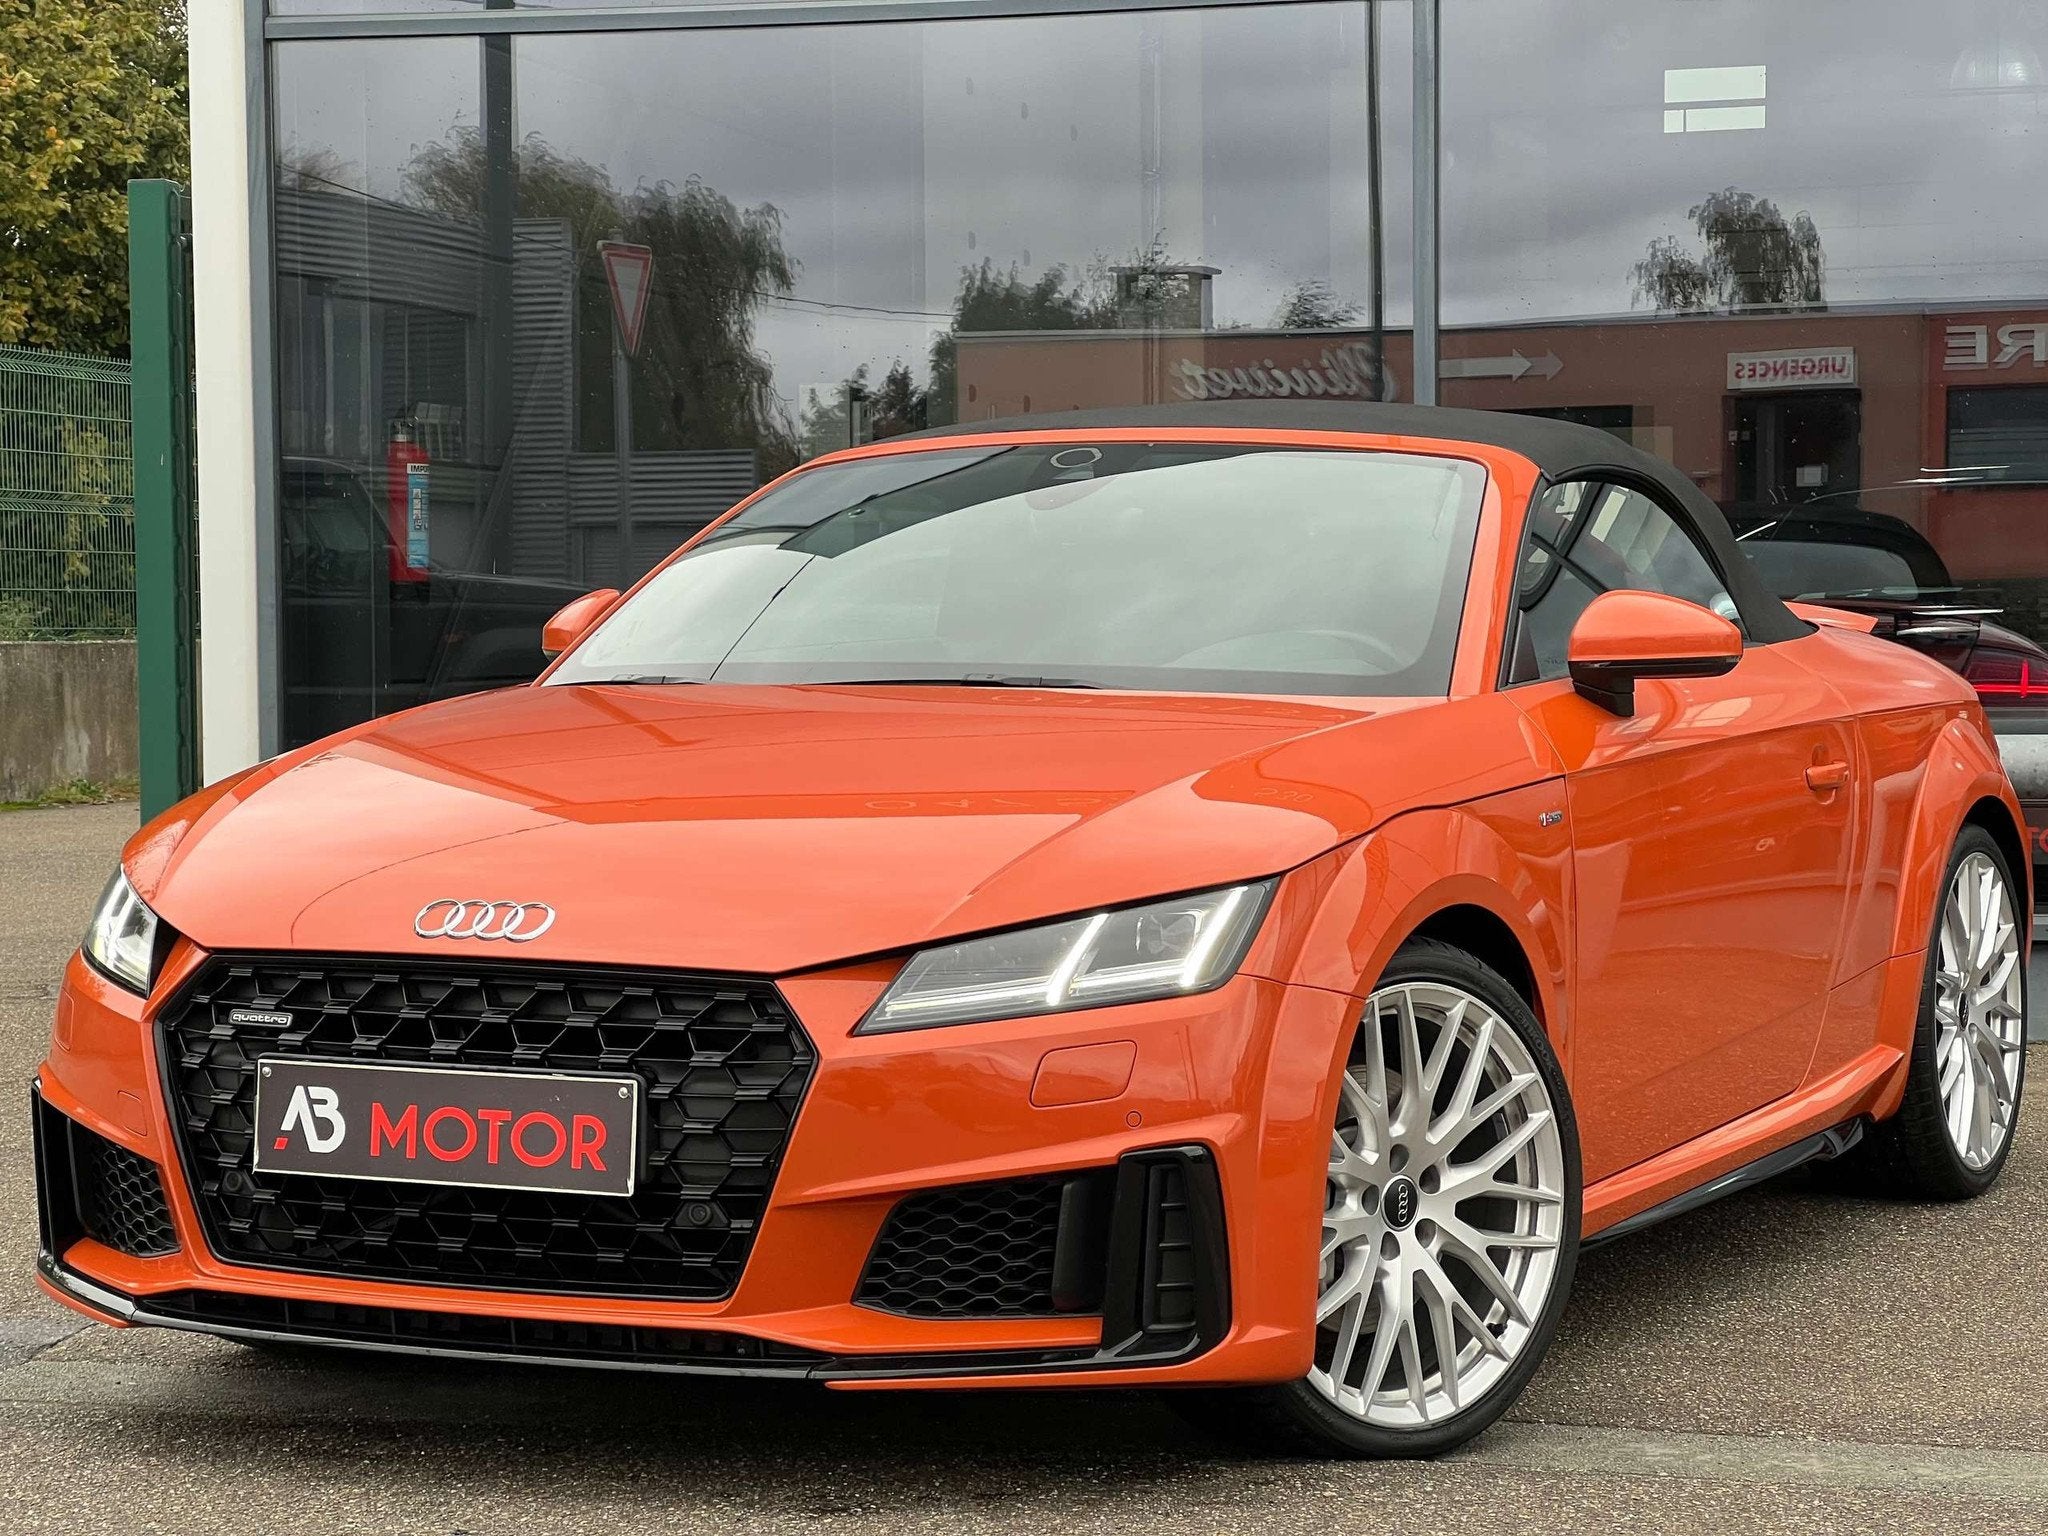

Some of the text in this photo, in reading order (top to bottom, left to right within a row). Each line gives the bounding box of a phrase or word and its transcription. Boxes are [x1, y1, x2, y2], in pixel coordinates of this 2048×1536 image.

[232, 1013, 287, 1024] quattro
[274, 1085, 607, 1171] AB MOTOR
